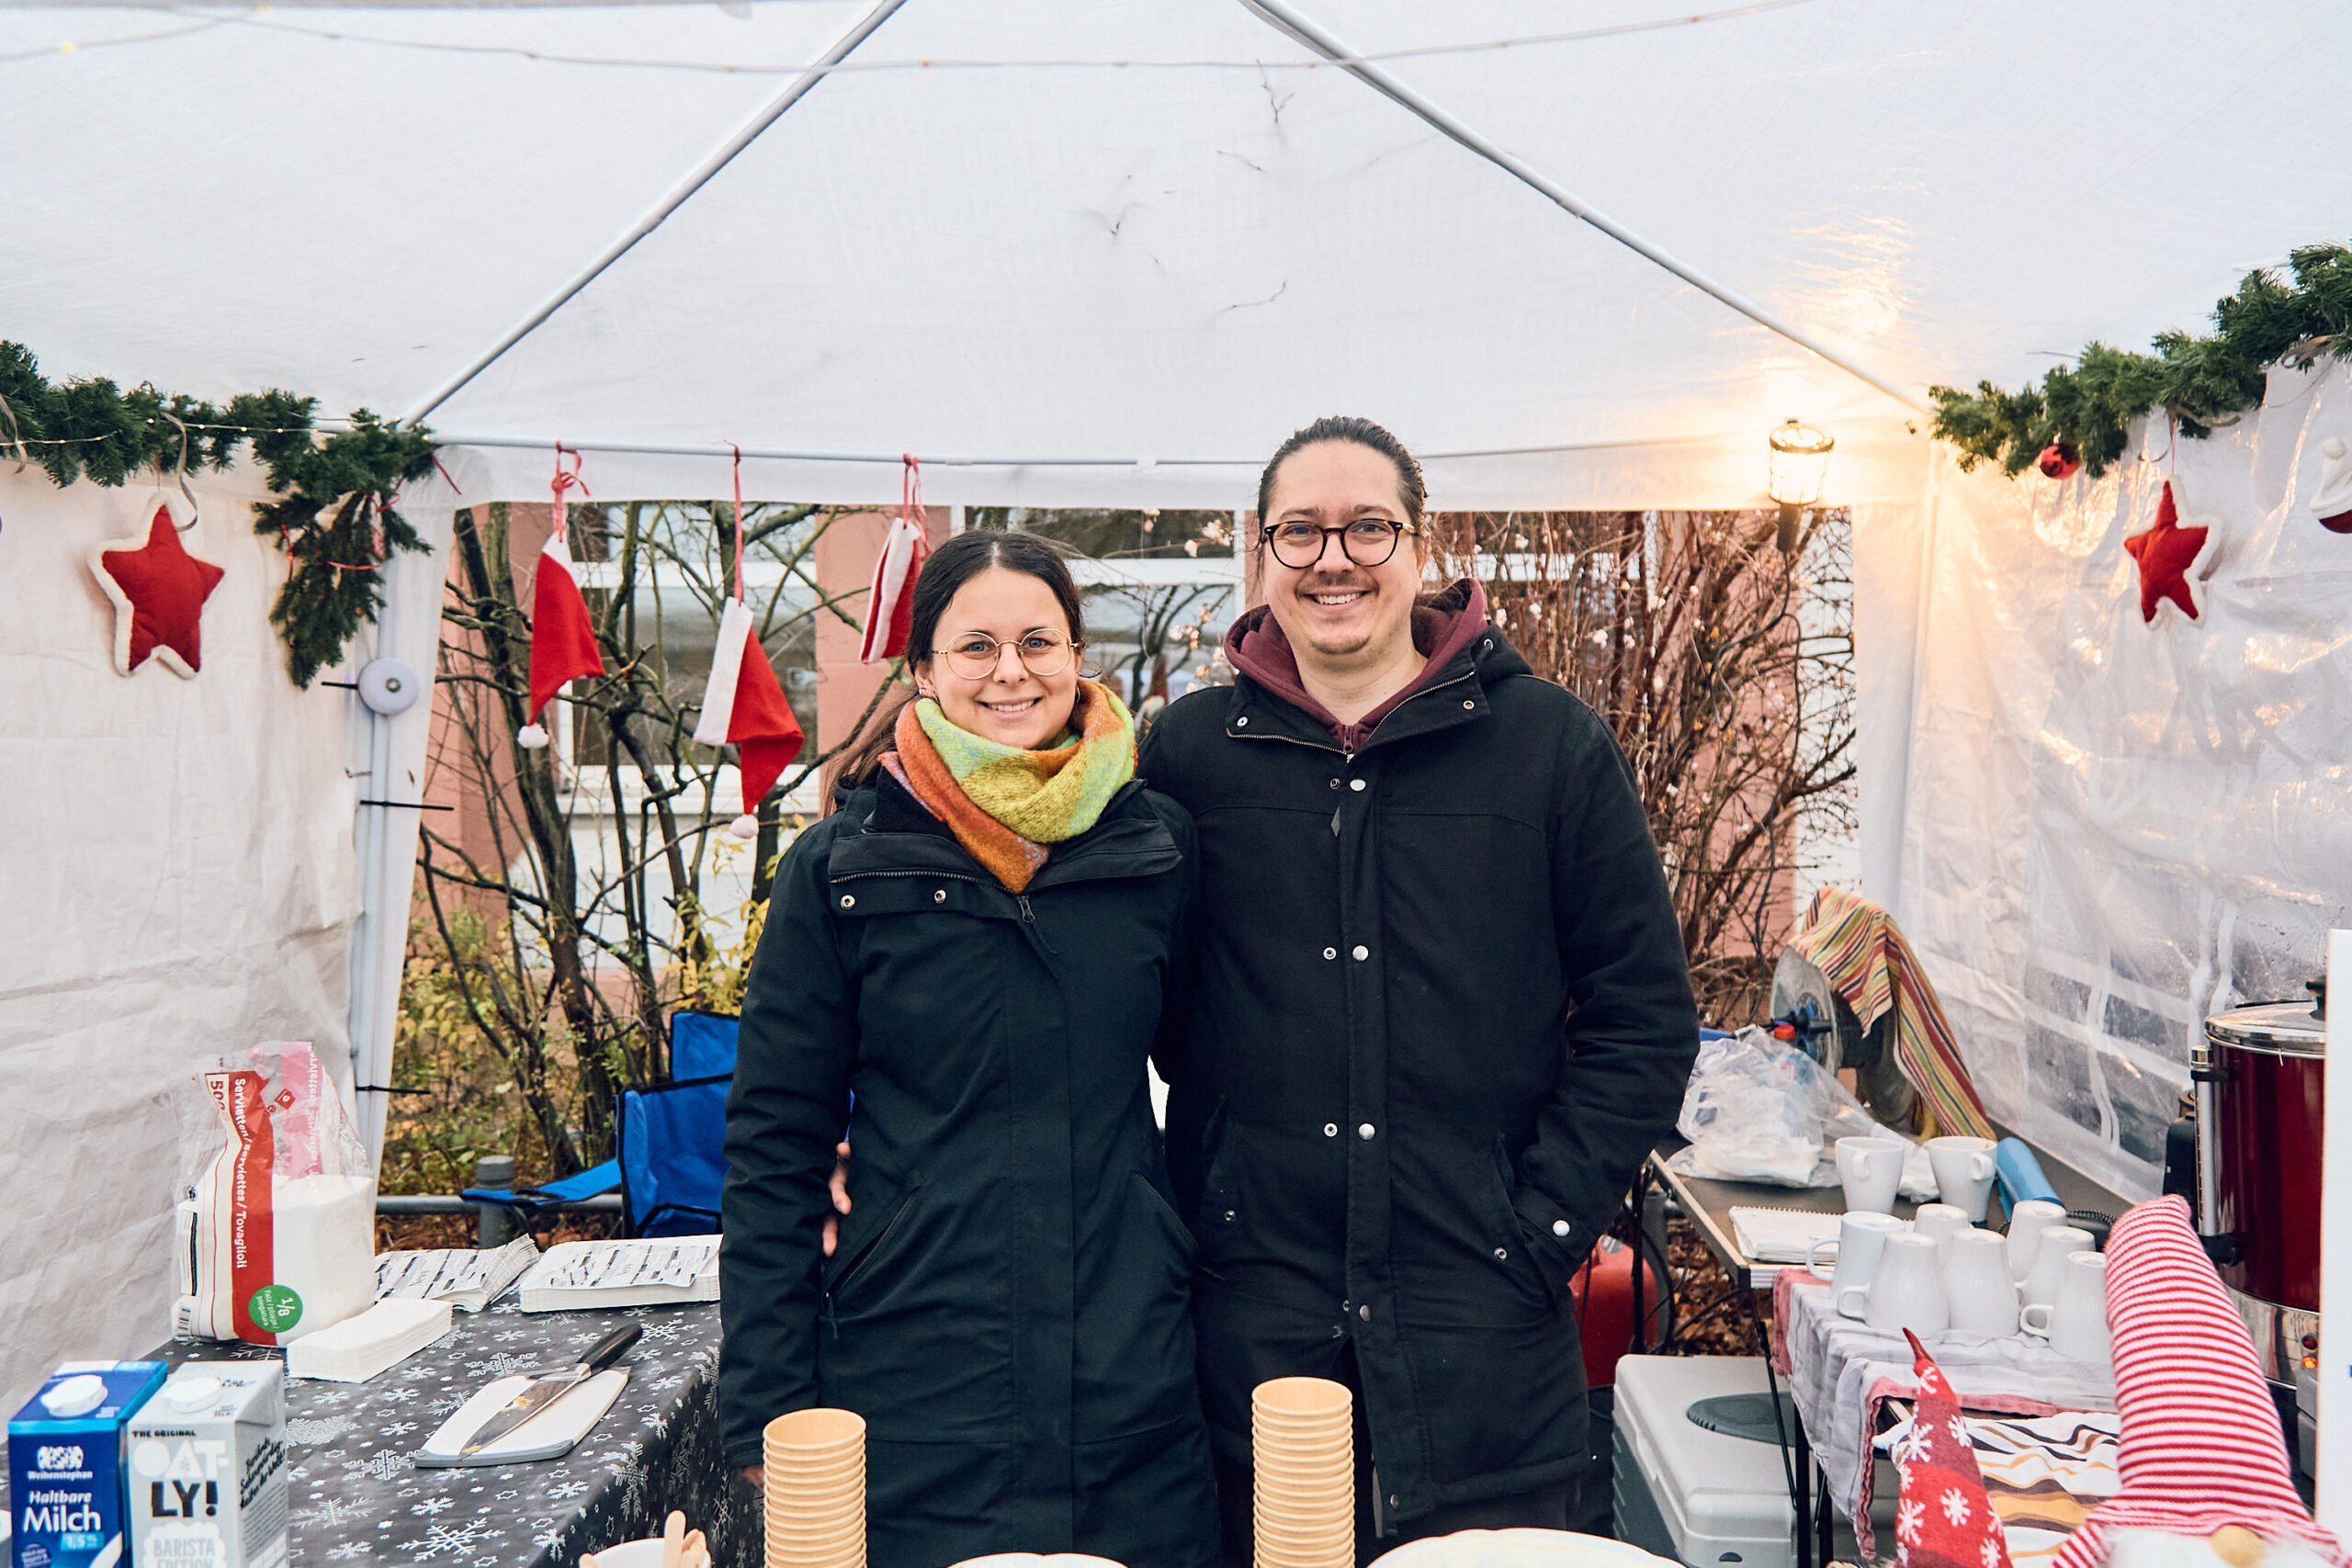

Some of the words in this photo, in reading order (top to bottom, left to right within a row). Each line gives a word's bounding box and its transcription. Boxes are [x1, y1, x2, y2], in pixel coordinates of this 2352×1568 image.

[233, 1211, 247, 1269] Tovaglioli
[277, 1297, 296, 1316] 1/8
[28, 1471, 93, 1481] Weihenstephan
[29, 1489, 92, 1504] Haltbare
[151, 1480, 218, 1517] LY!
[23, 1504, 101, 1532] Milch
[66, 1535, 85, 1549] 1,5
[153, 1538, 216, 1558] BARISTA
